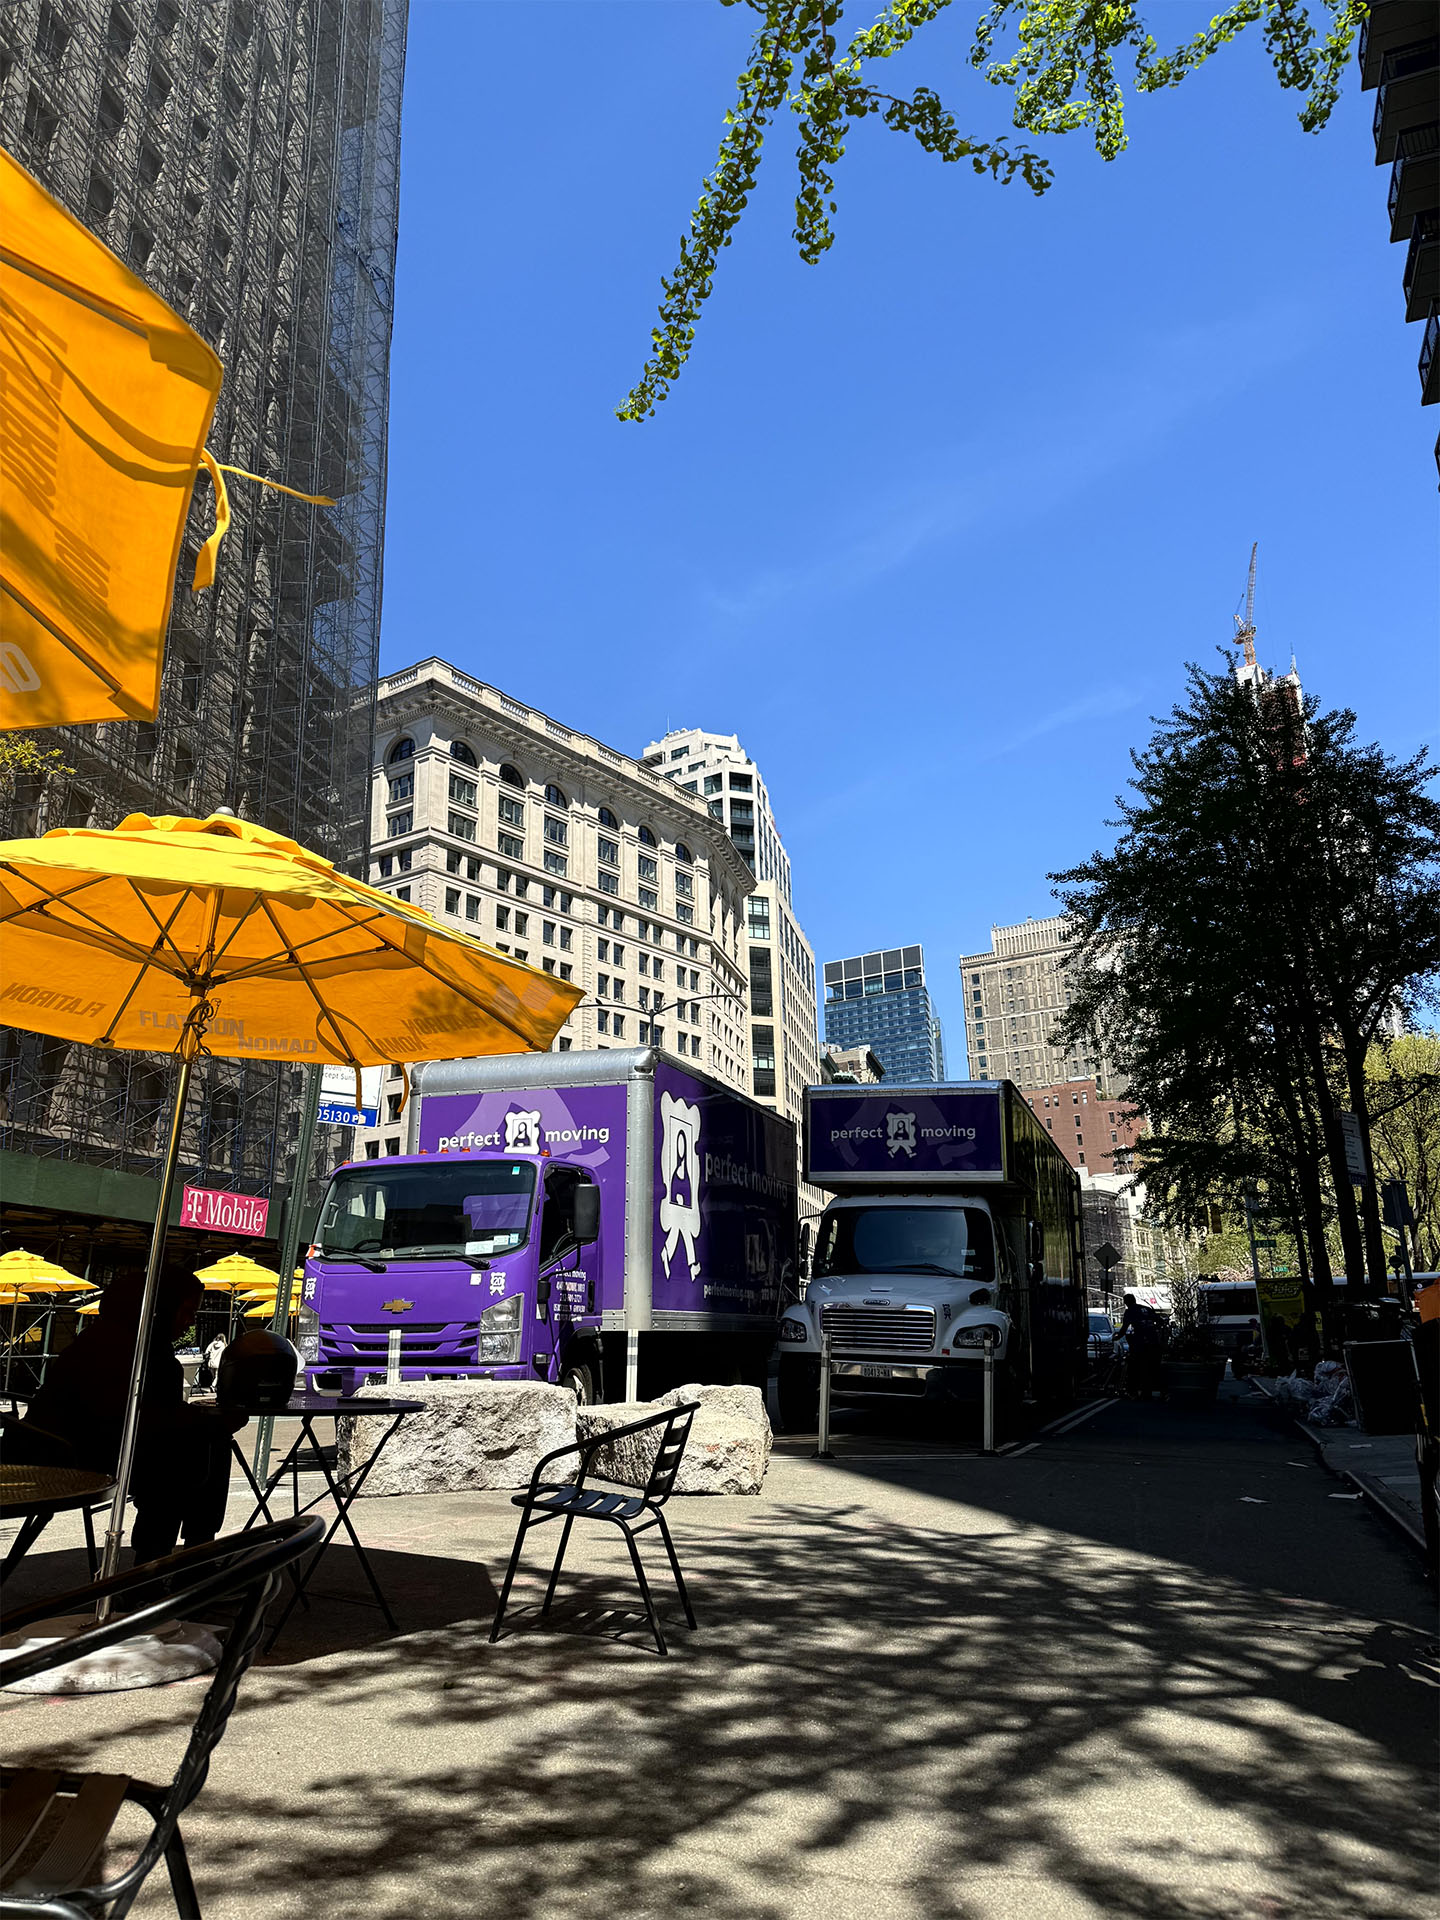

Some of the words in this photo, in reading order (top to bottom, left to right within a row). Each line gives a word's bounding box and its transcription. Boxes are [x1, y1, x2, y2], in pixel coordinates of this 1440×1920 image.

[237, 1035, 318, 1054] NOMAD
[438, 1132, 500, 1153] perfect
[544, 1125, 609, 1143] moving
[831, 1127, 883, 1142] perfect
[920, 1125, 976, 1139] moving
[705, 1152, 748, 1189] perfect
